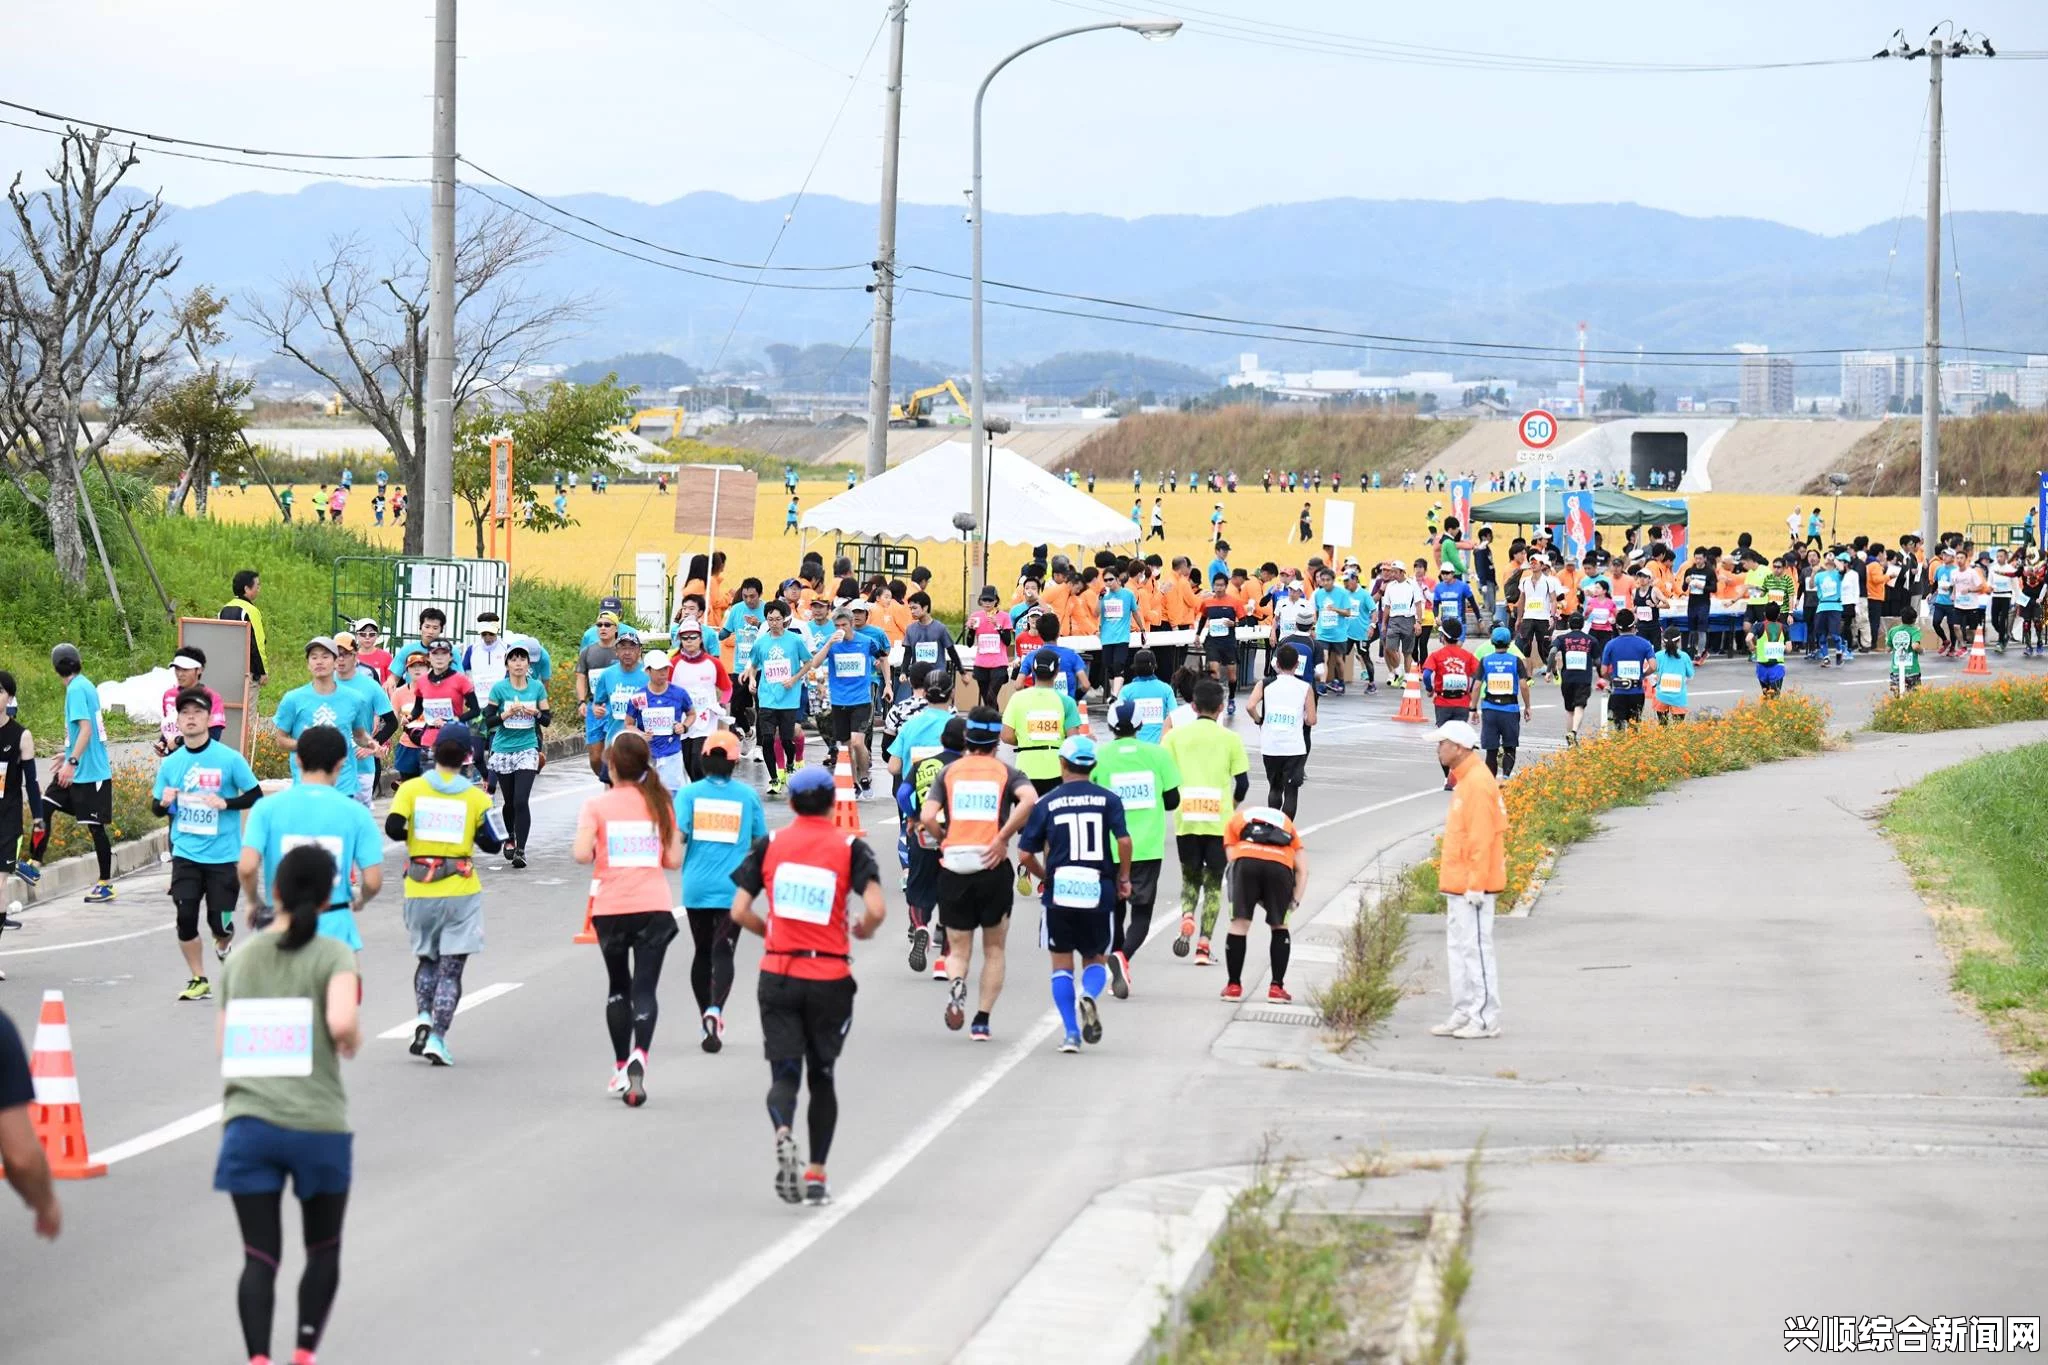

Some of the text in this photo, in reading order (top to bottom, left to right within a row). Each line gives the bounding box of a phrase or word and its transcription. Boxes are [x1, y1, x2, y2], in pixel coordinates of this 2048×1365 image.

[1527, 421, 1549, 438] 50
[1519, 451, 1554, 461] ここから
[768, 666, 788, 677] 31190
[1036, 720, 1059, 731] 484
[1119, 784, 1150, 799] 20243
[965, 794, 997, 809] 21182
[182, 807, 213, 824] 21636
[1053, 812, 1103, 861] 10
[782, 882, 825, 907] 21164
